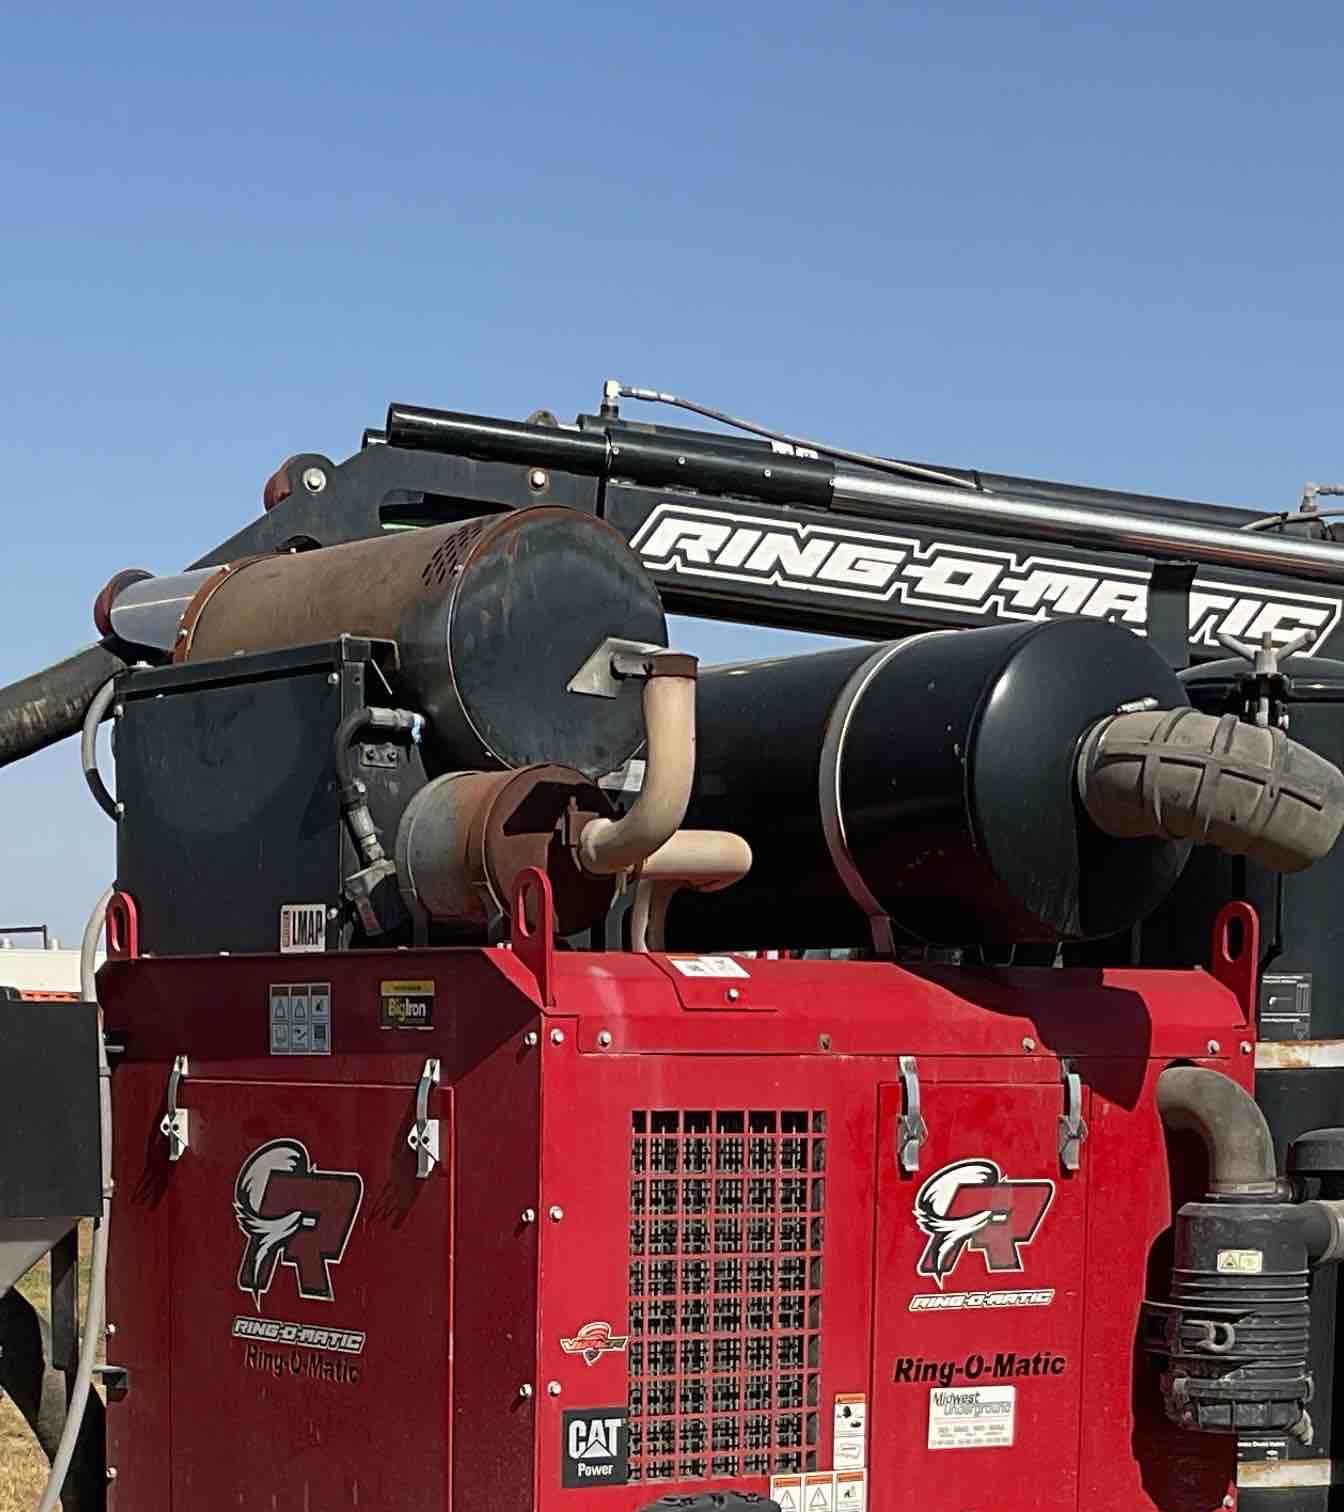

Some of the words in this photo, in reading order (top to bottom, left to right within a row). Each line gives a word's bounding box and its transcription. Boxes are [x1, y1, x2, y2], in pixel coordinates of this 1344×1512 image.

[637, 513, 1332, 650] RING-O-MATIC
[388, 997, 426, 1022] BigIron
[910, 1290, 1054, 1311] RING-O-MATIC
[234, 1318, 363, 1350] RING-O-MATIC
[242, 1343, 360, 1384] Ring-O-Matic
[893, 1352, 1067, 1386] Ring-O-Matic
[933, 1391, 981, 1407] Midwest
[568, 1418, 623, 1459] CAT
[577, 1462, 614, 1478] Power
